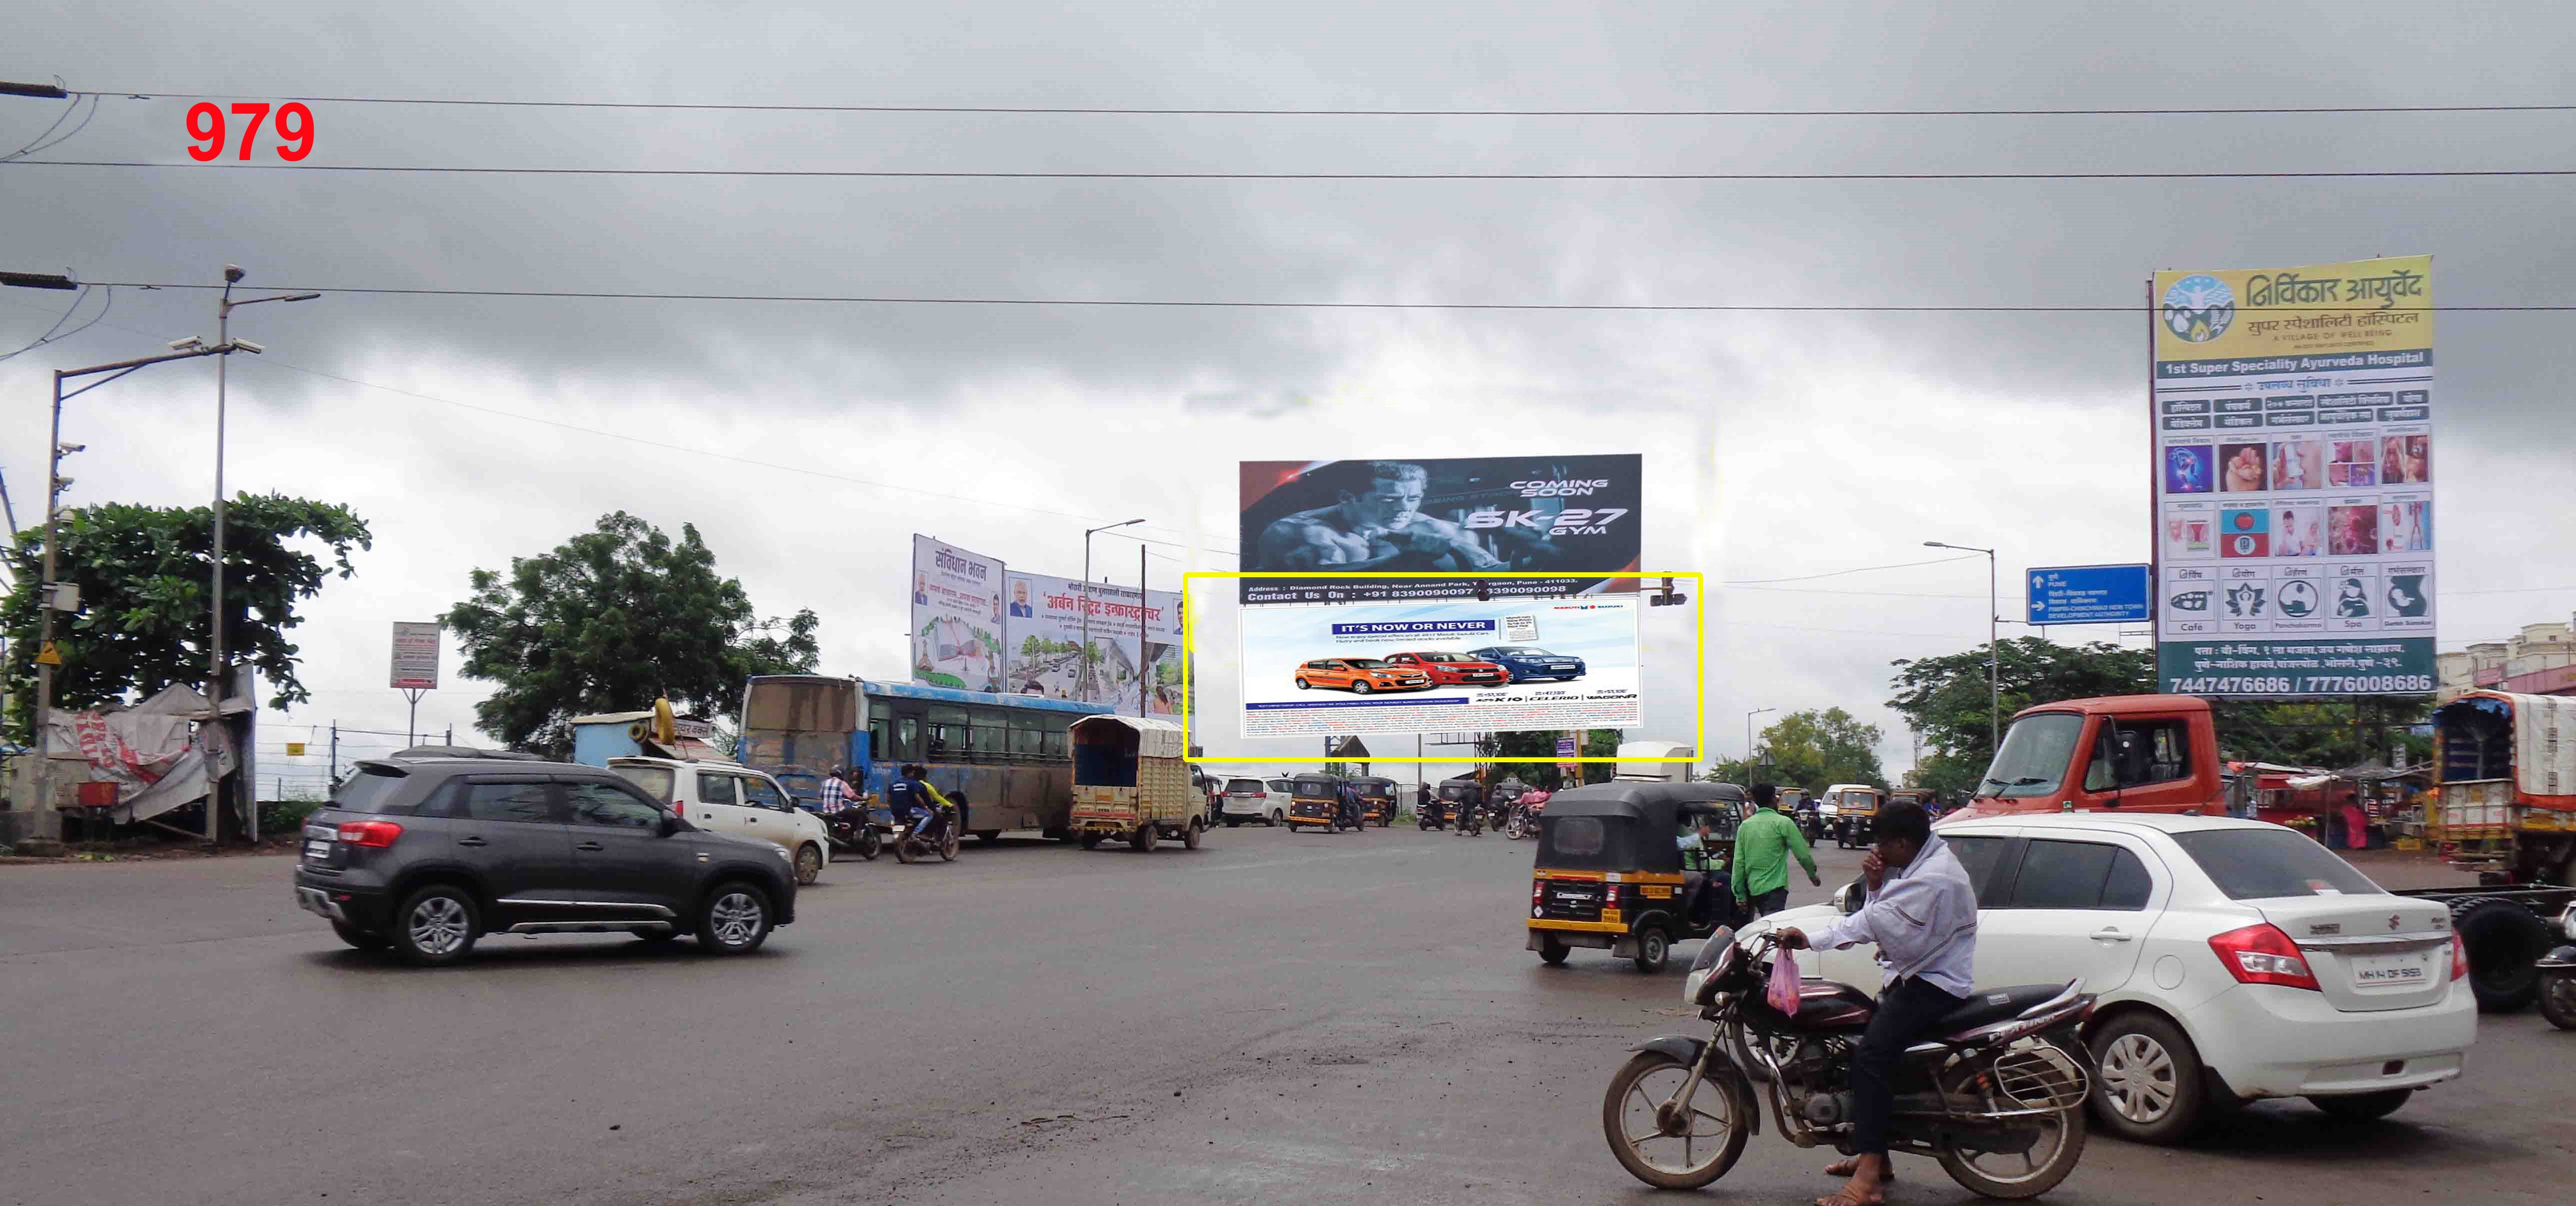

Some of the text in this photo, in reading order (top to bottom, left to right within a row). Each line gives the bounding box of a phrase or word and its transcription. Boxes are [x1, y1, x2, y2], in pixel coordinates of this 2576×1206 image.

[2246, 269, 2424, 309] निर्विकार आयुर्वेद
[2248, 310, 2419, 336] सुपर स्पेशालिटी हॉस्पिटल
[2282, 333, 2318, 341] VILLAGE
[2323, 332, 2336, 340] OF
[2341, 330, 2362, 338] WELL
[2364, 329, 2392, 337] BEING
[2166, 352, 2424, 375] 1st Super Speciality Ayurveda Hospital
[1509, 479, 1610, 489] COMING
[1520, 487, 1594, 498] SOON
[1464, 508, 1629, 529] SK-27
[1548, 526, 1608, 536] GYM
[935, 548, 967, 576] संविधान
[968, 561, 988, 582] भवन
[1247, 592, 1297, 601] Contact
[1304, 591, 1320, 600] Us
[1363, 590, 1388, 598] +91
[1391, 587, 1474, 598] 8390090097
[1341, 622, 1486, 632] IT'S NOW OR NEVER
[2234, 622, 2256, 630] Yoga
[2344, 620, 2362, 628] Spa
[2170, 676, 2290, 693] 7447476686
[2306, 674, 2432, 692] 7776008686
